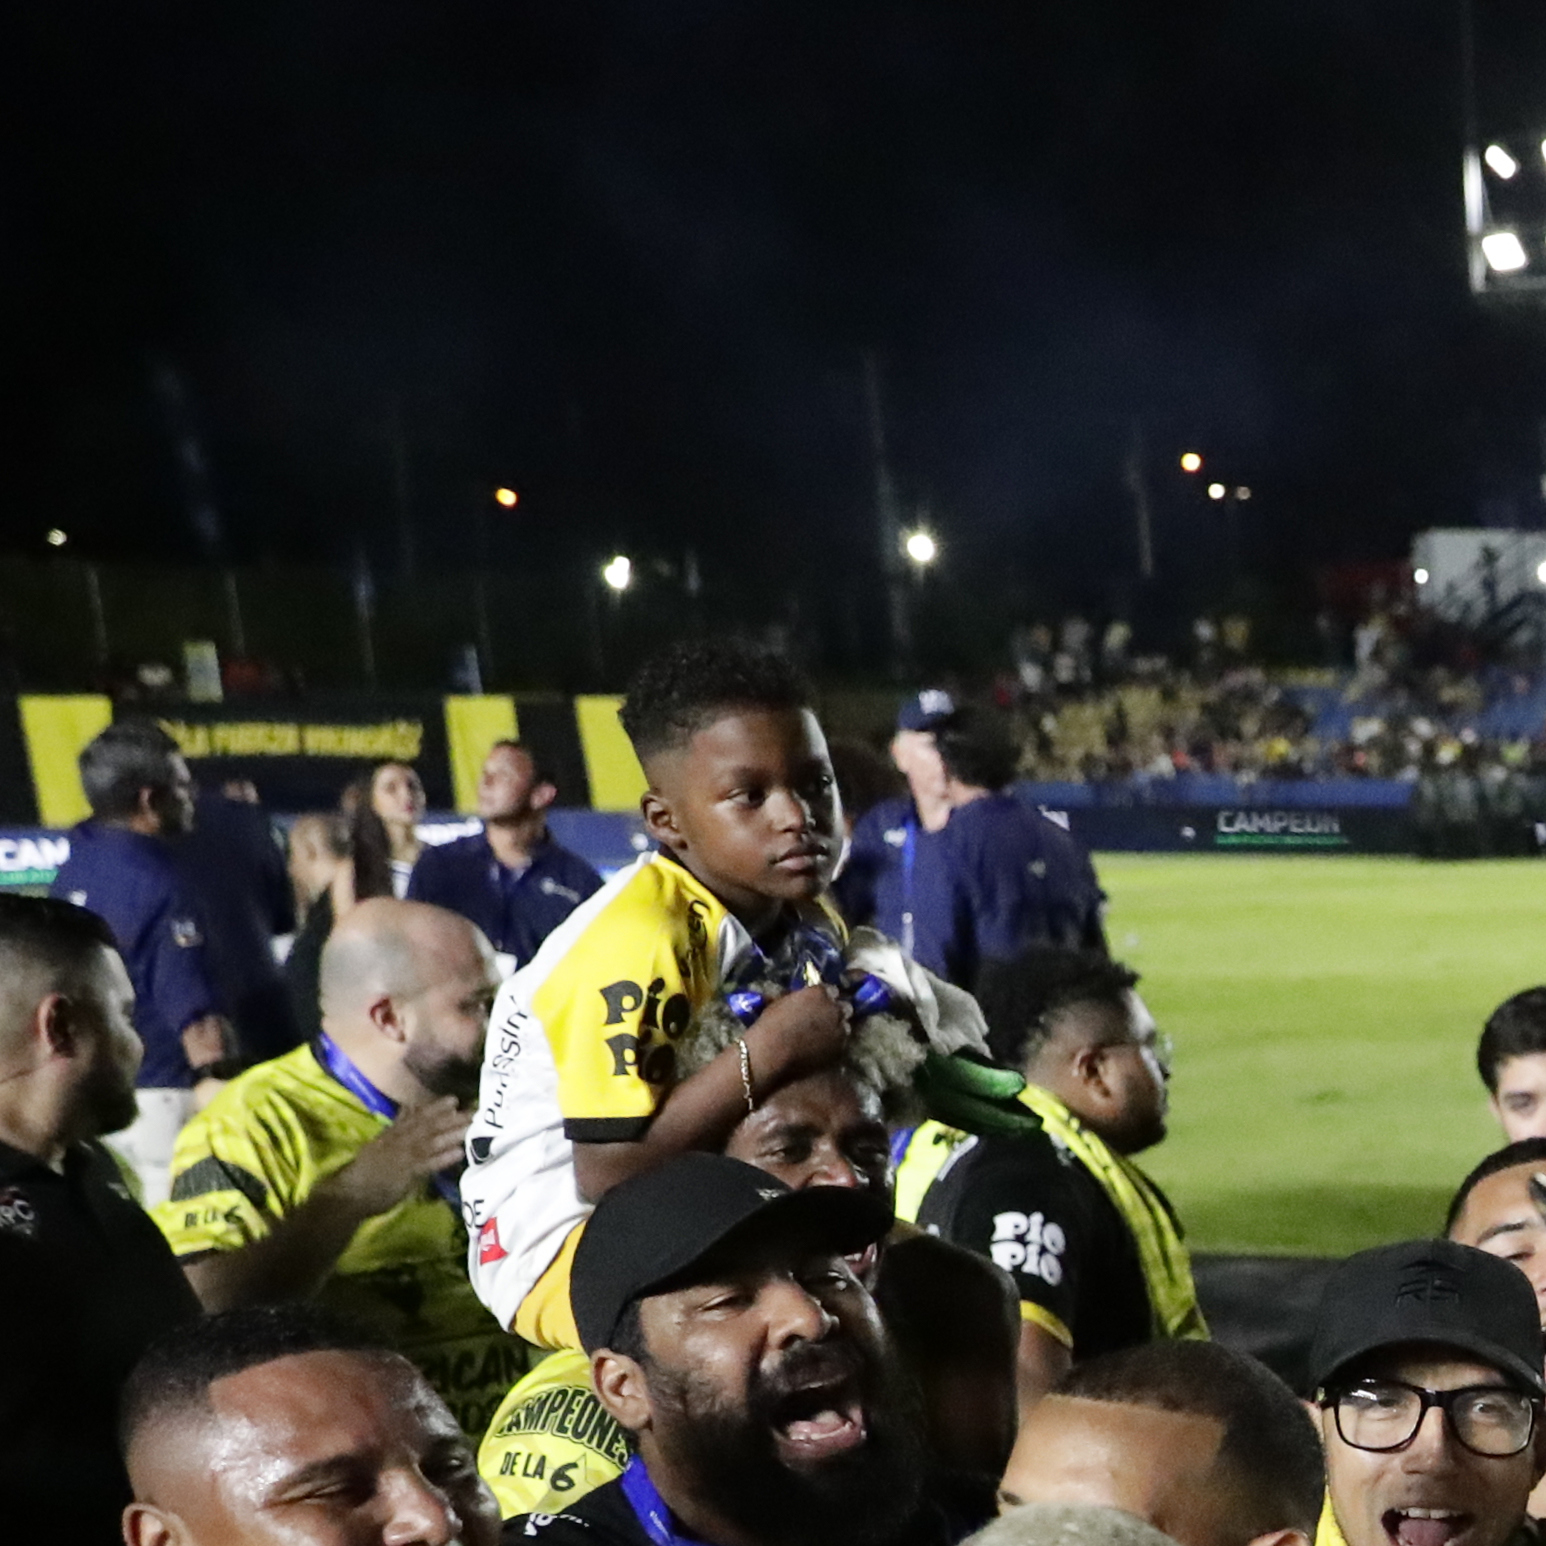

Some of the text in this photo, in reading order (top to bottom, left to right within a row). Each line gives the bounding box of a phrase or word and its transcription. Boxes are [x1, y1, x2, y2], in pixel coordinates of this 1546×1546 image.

[991, 1211, 1066, 1256] Pio
[990, 1240, 1062, 1286] Pio
[500, 1451, 579, 1492] DE LA 6
